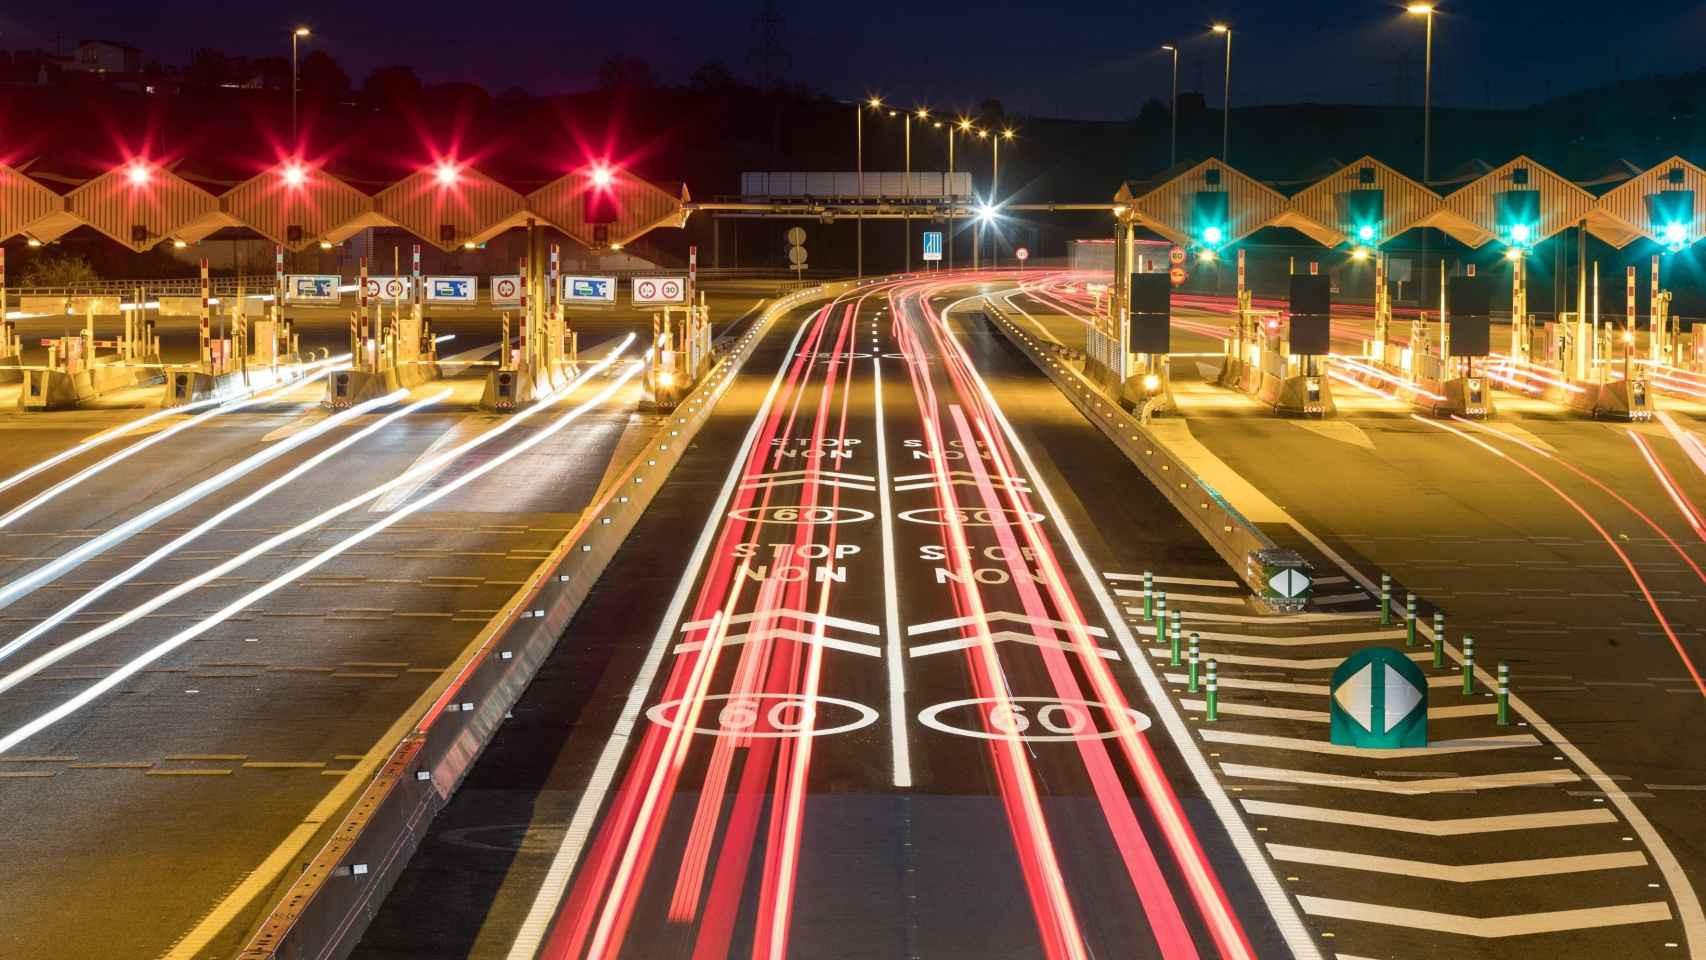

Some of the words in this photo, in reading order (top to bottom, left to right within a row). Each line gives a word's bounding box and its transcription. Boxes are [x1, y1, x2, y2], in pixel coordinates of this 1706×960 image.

[769, 438, 862, 447] STOP
[774, 449, 853, 459] NON
[773, 508, 834, 521] 60
[730, 543, 861, 559] STOP
[734, 565, 846, 582] NON
[718, 701, 816, 731] 60
[989, 703, 1086, 733] 60
